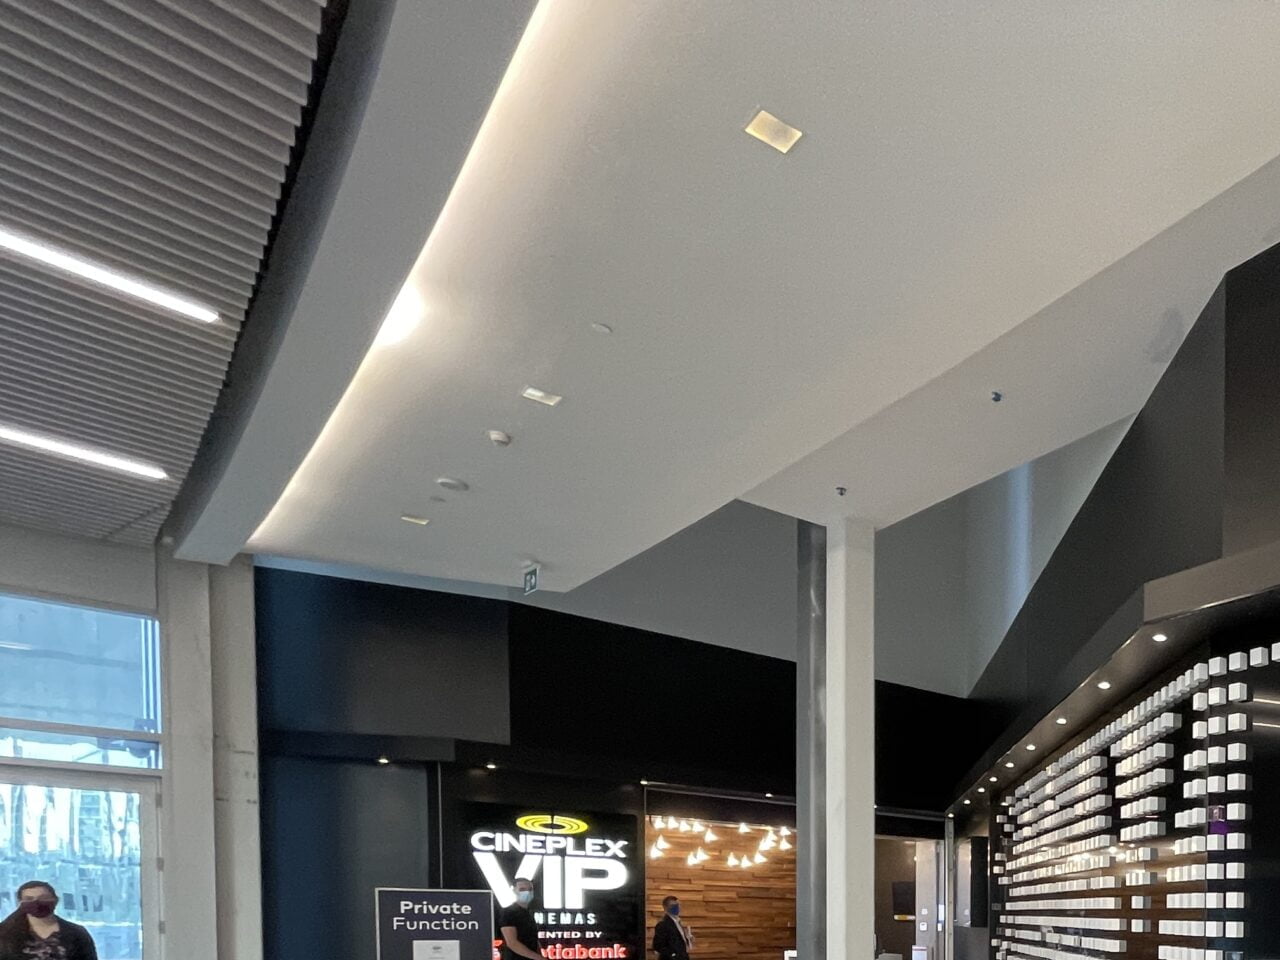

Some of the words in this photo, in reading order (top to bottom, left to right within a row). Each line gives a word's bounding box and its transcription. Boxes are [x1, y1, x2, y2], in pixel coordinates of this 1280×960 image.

[470, 831, 629, 858] CINEPLEX
[473, 852, 629, 909] VIP
[400, 901, 472, 914] Private
[393, 917, 479, 930] Function
[534, 912, 596, 925] NEMAS
[537, 931, 581, 939] ENTED
[585, 931, 603, 939] BY
[541, 943, 627, 960] tiabank
